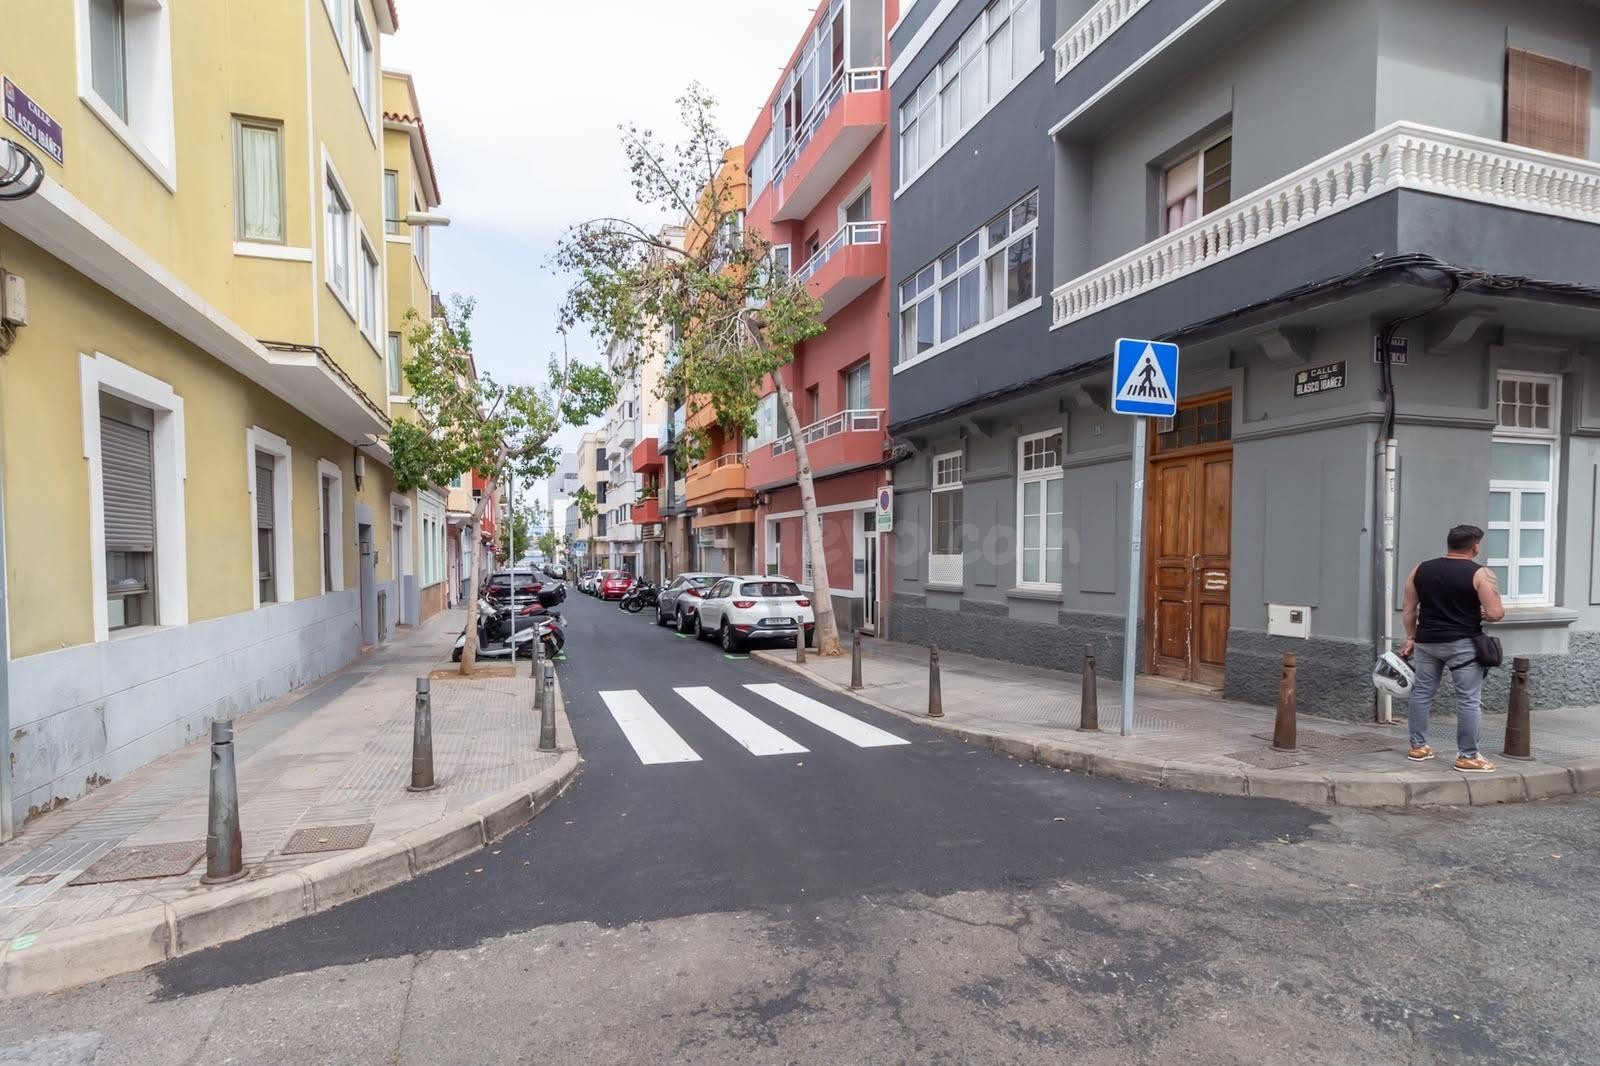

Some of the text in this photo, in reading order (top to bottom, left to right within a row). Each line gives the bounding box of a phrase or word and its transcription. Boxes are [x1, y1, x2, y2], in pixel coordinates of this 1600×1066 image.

[7, 102, 36, 140] BLASCO
[27, 101, 51, 127] CALLE
[1311, 364, 1338, 377] CALLE
[1296, 381, 1320, 395] BLASCO
